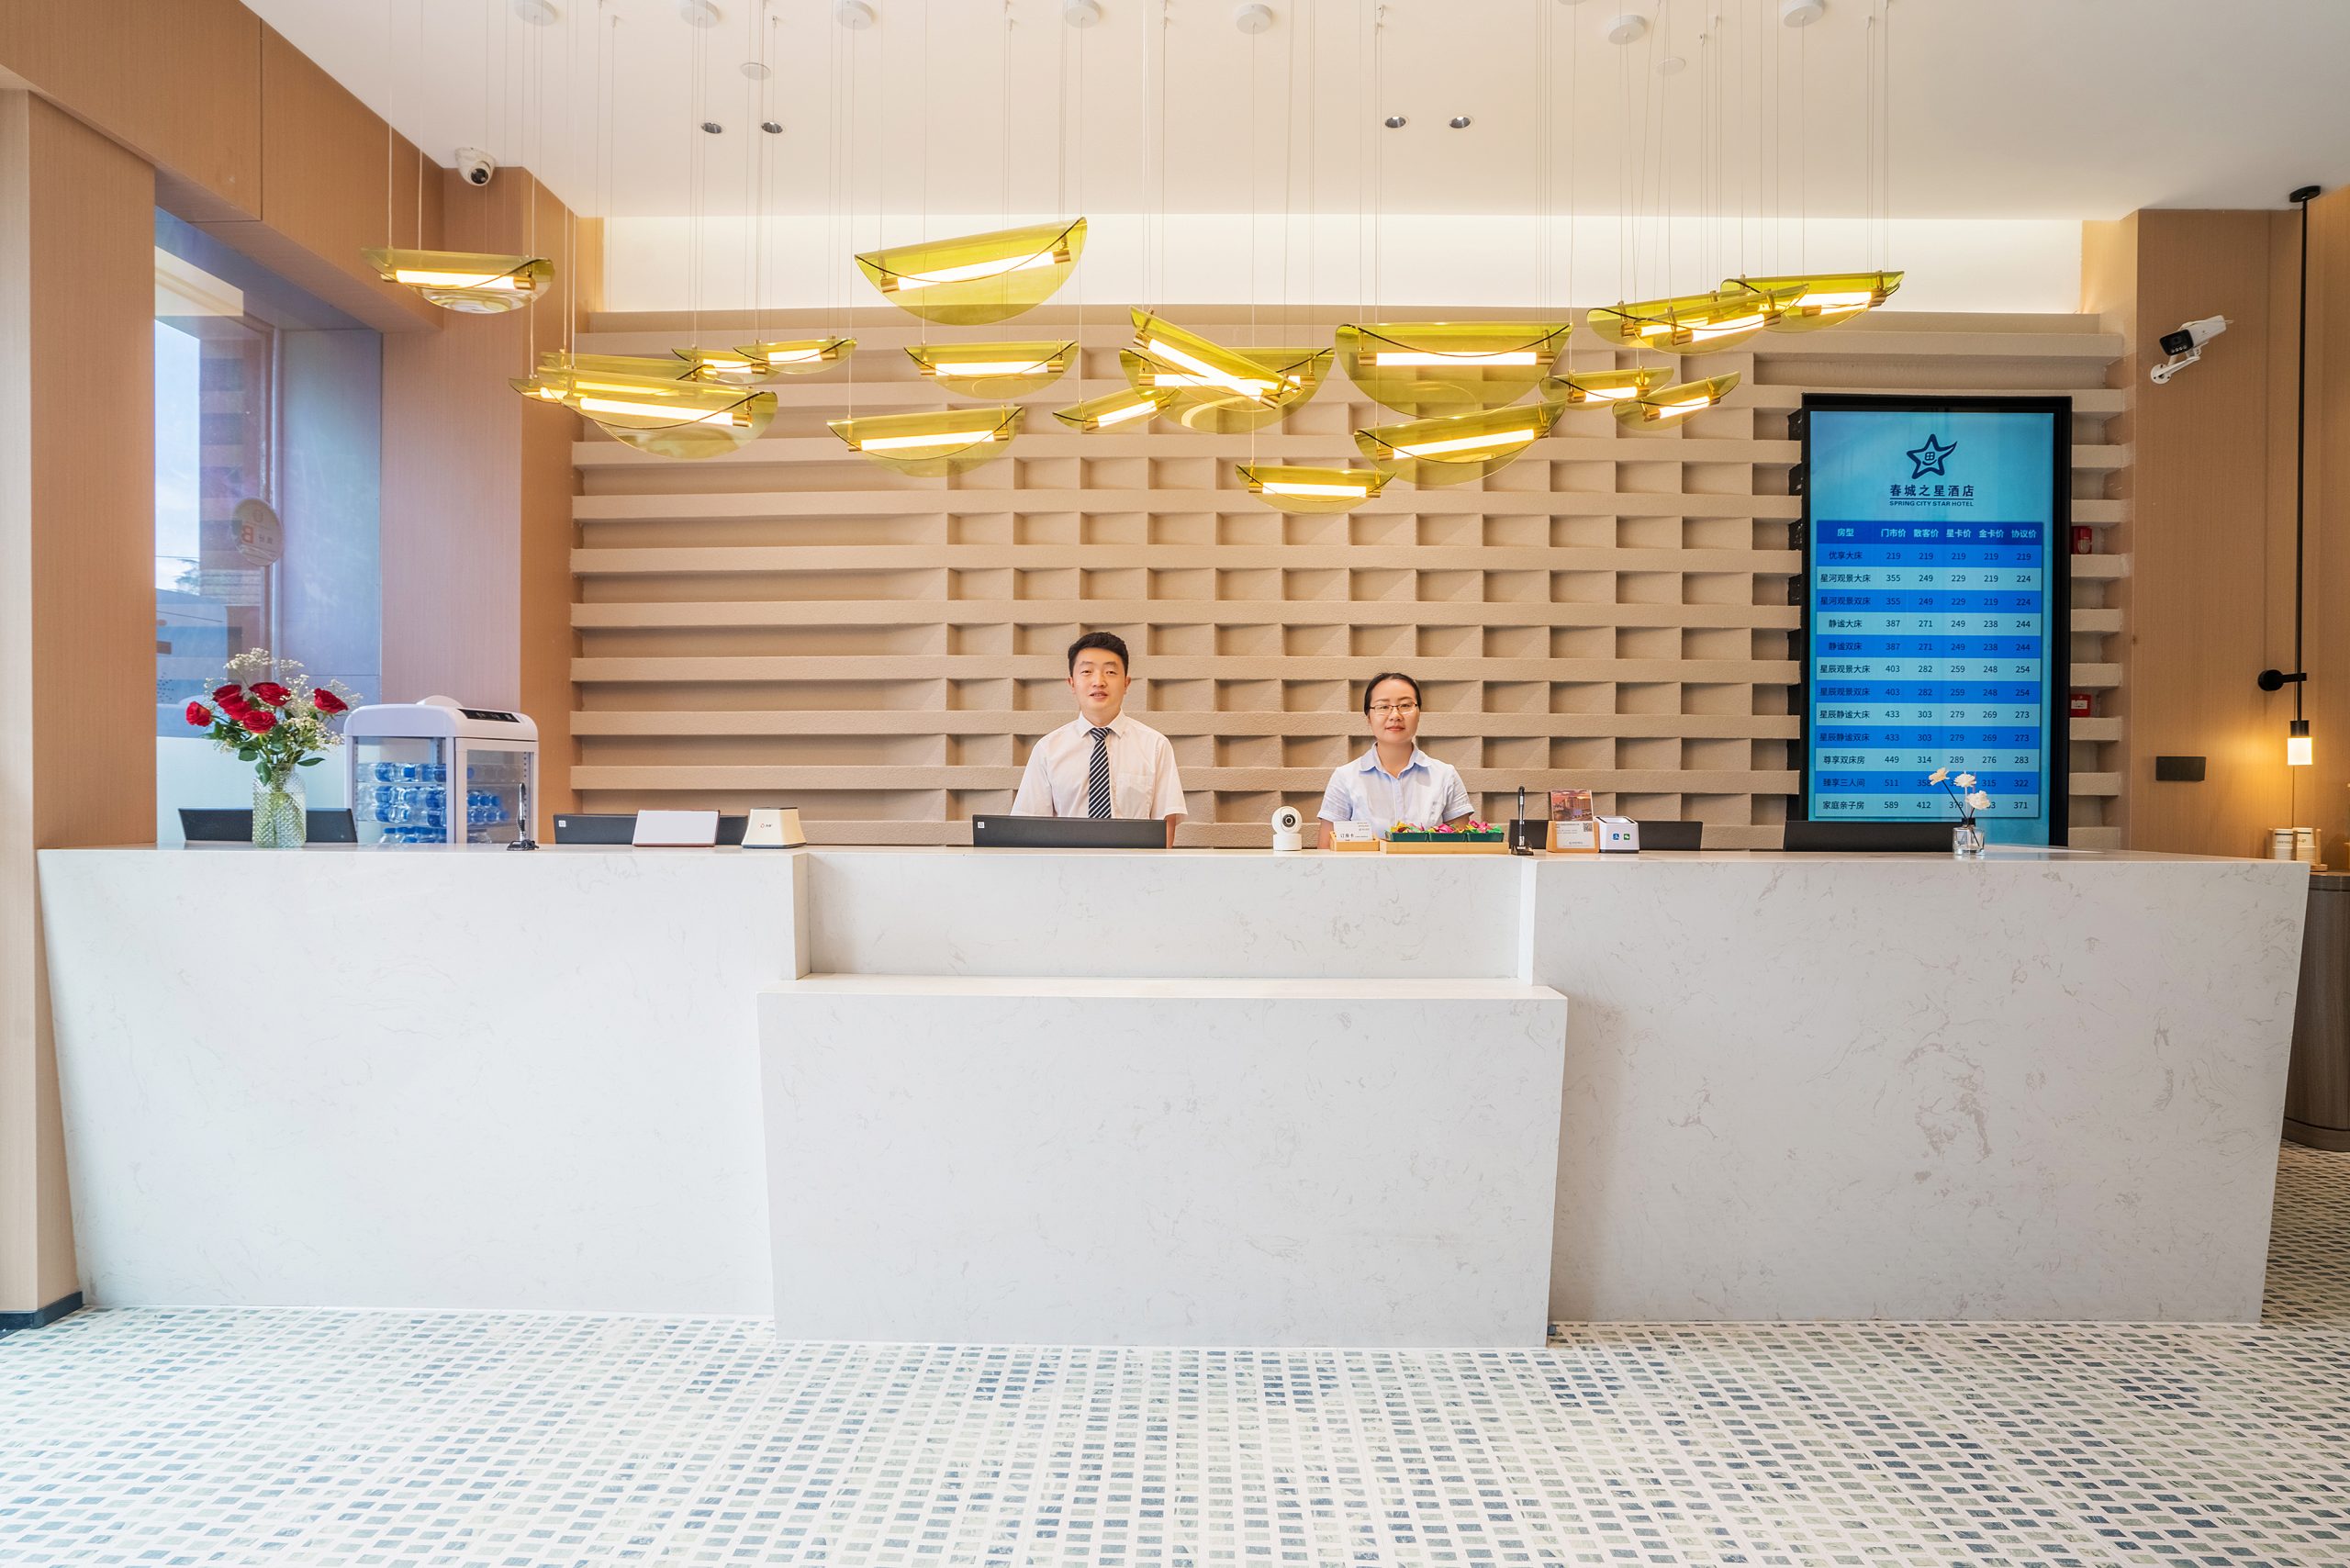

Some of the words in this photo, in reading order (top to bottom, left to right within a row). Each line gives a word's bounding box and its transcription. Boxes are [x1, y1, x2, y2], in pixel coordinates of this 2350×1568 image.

[1889, 484, 1975, 497] 春城之星酒店
[1837, 528, 1854, 537] 房型
[1880, 528, 1907, 538] 门市价
[1913, 528, 1939, 538] 散客价
[1946, 528, 1971, 538] 星卡价
[1978, 529, 2004, 538] 金卡价
[2011, 529, 2037, 539] 协议价
[1829, 551, 1863, 560] 优享大床
[1886, 552, 1901, 560] 219
[1919, 552, 1934, 560] 219
[1952, 552, 1966, 560] 219
[1984, 553, 1999, 561] 219
[2016, 553, 2031, 561] 219
[1820, 574, 1871, 583] 星河观景大床
[1886, 574, 1901, 582] 355
[1919, 574, 1934, 582] 249
[1951, 574, 1966, 583] 229
[1984, 575, 1999, 583] 219
[2016, 575, 2031, 583] 224
[1820, 597, 1871, 606] 星河观景双床
[1886, 597, 1901, 605] 355
[1919, 598, 1933, 606] 249
[1952, 598, 1966, 606] 229
[1984, 598, 1998, 606] 219
[2016, 598, 2031, 606] 224
[1886, 619, 1900, 628] 387
[1918, 620, 1933, 628] 271
[1951, 620, 1966, 628] 249
[1984, 620, 1998, 628] 238
[2016, 620, 2031, 628] 244
[1886, 643, 1900, 651] 387
[1918, 643, 1932, 651] 271
[1951, 643, 1965, 651] 249
[1984, 643, 1998, 651] 238
[1819, 665, 1871, 674] 星辰观景大床
[1885, 665, 1900, 673] 403
[1918, 665, 1933, 673] 282
[1951, 665, 1965, 673] 259
[1983, 665, 1998, 674] 248
[2015, 665, 2031, 674] 254
[1819, 688, 1871, 697] 星辰观景双床
[1886, 688, 1900, 696] 403
[1918, 689, 1932, 697] 282
[1951, 689, 1965, 697] 259
[1983, 689, 1998, 697] 248
[2015, 689, 2030, 697] 254
[1885, 710, 1900, 719] 433
[1918, 710, 1932, 719] 303
[1950, 711, 1965, 719] 279
[1982, 711, 1998, 719] 269
[2015, 711, 2030, 719] 273
[1885, 734, 1899, 742] 433
[1918, 734, 1932, 742] 303
[1950, 734, 1964, 742] 279
[1983, 734, 1998, 742] 269
[2014, 734, 2030, 742] 273
[1823, 756, 1865, 765] 尊享双床房
[1884, 756, 1900, 764] 449
[1917, 756, 1931, 764] 314
[1949, 756, 1964, 764] 289
[1982, 756, 1998, 764] 276
[2014, 756, 2030, 765] 283
[1885, 778, 1898, 787] 511
[2014, 779, 2029, 788] 322
[1822, 801, 1864, 810] 家庭亲子房
[1884, 801, 1899, 809] 589
[1917, 801, 1931, 809] 412
[2013, 801, 2028, 810] 371
